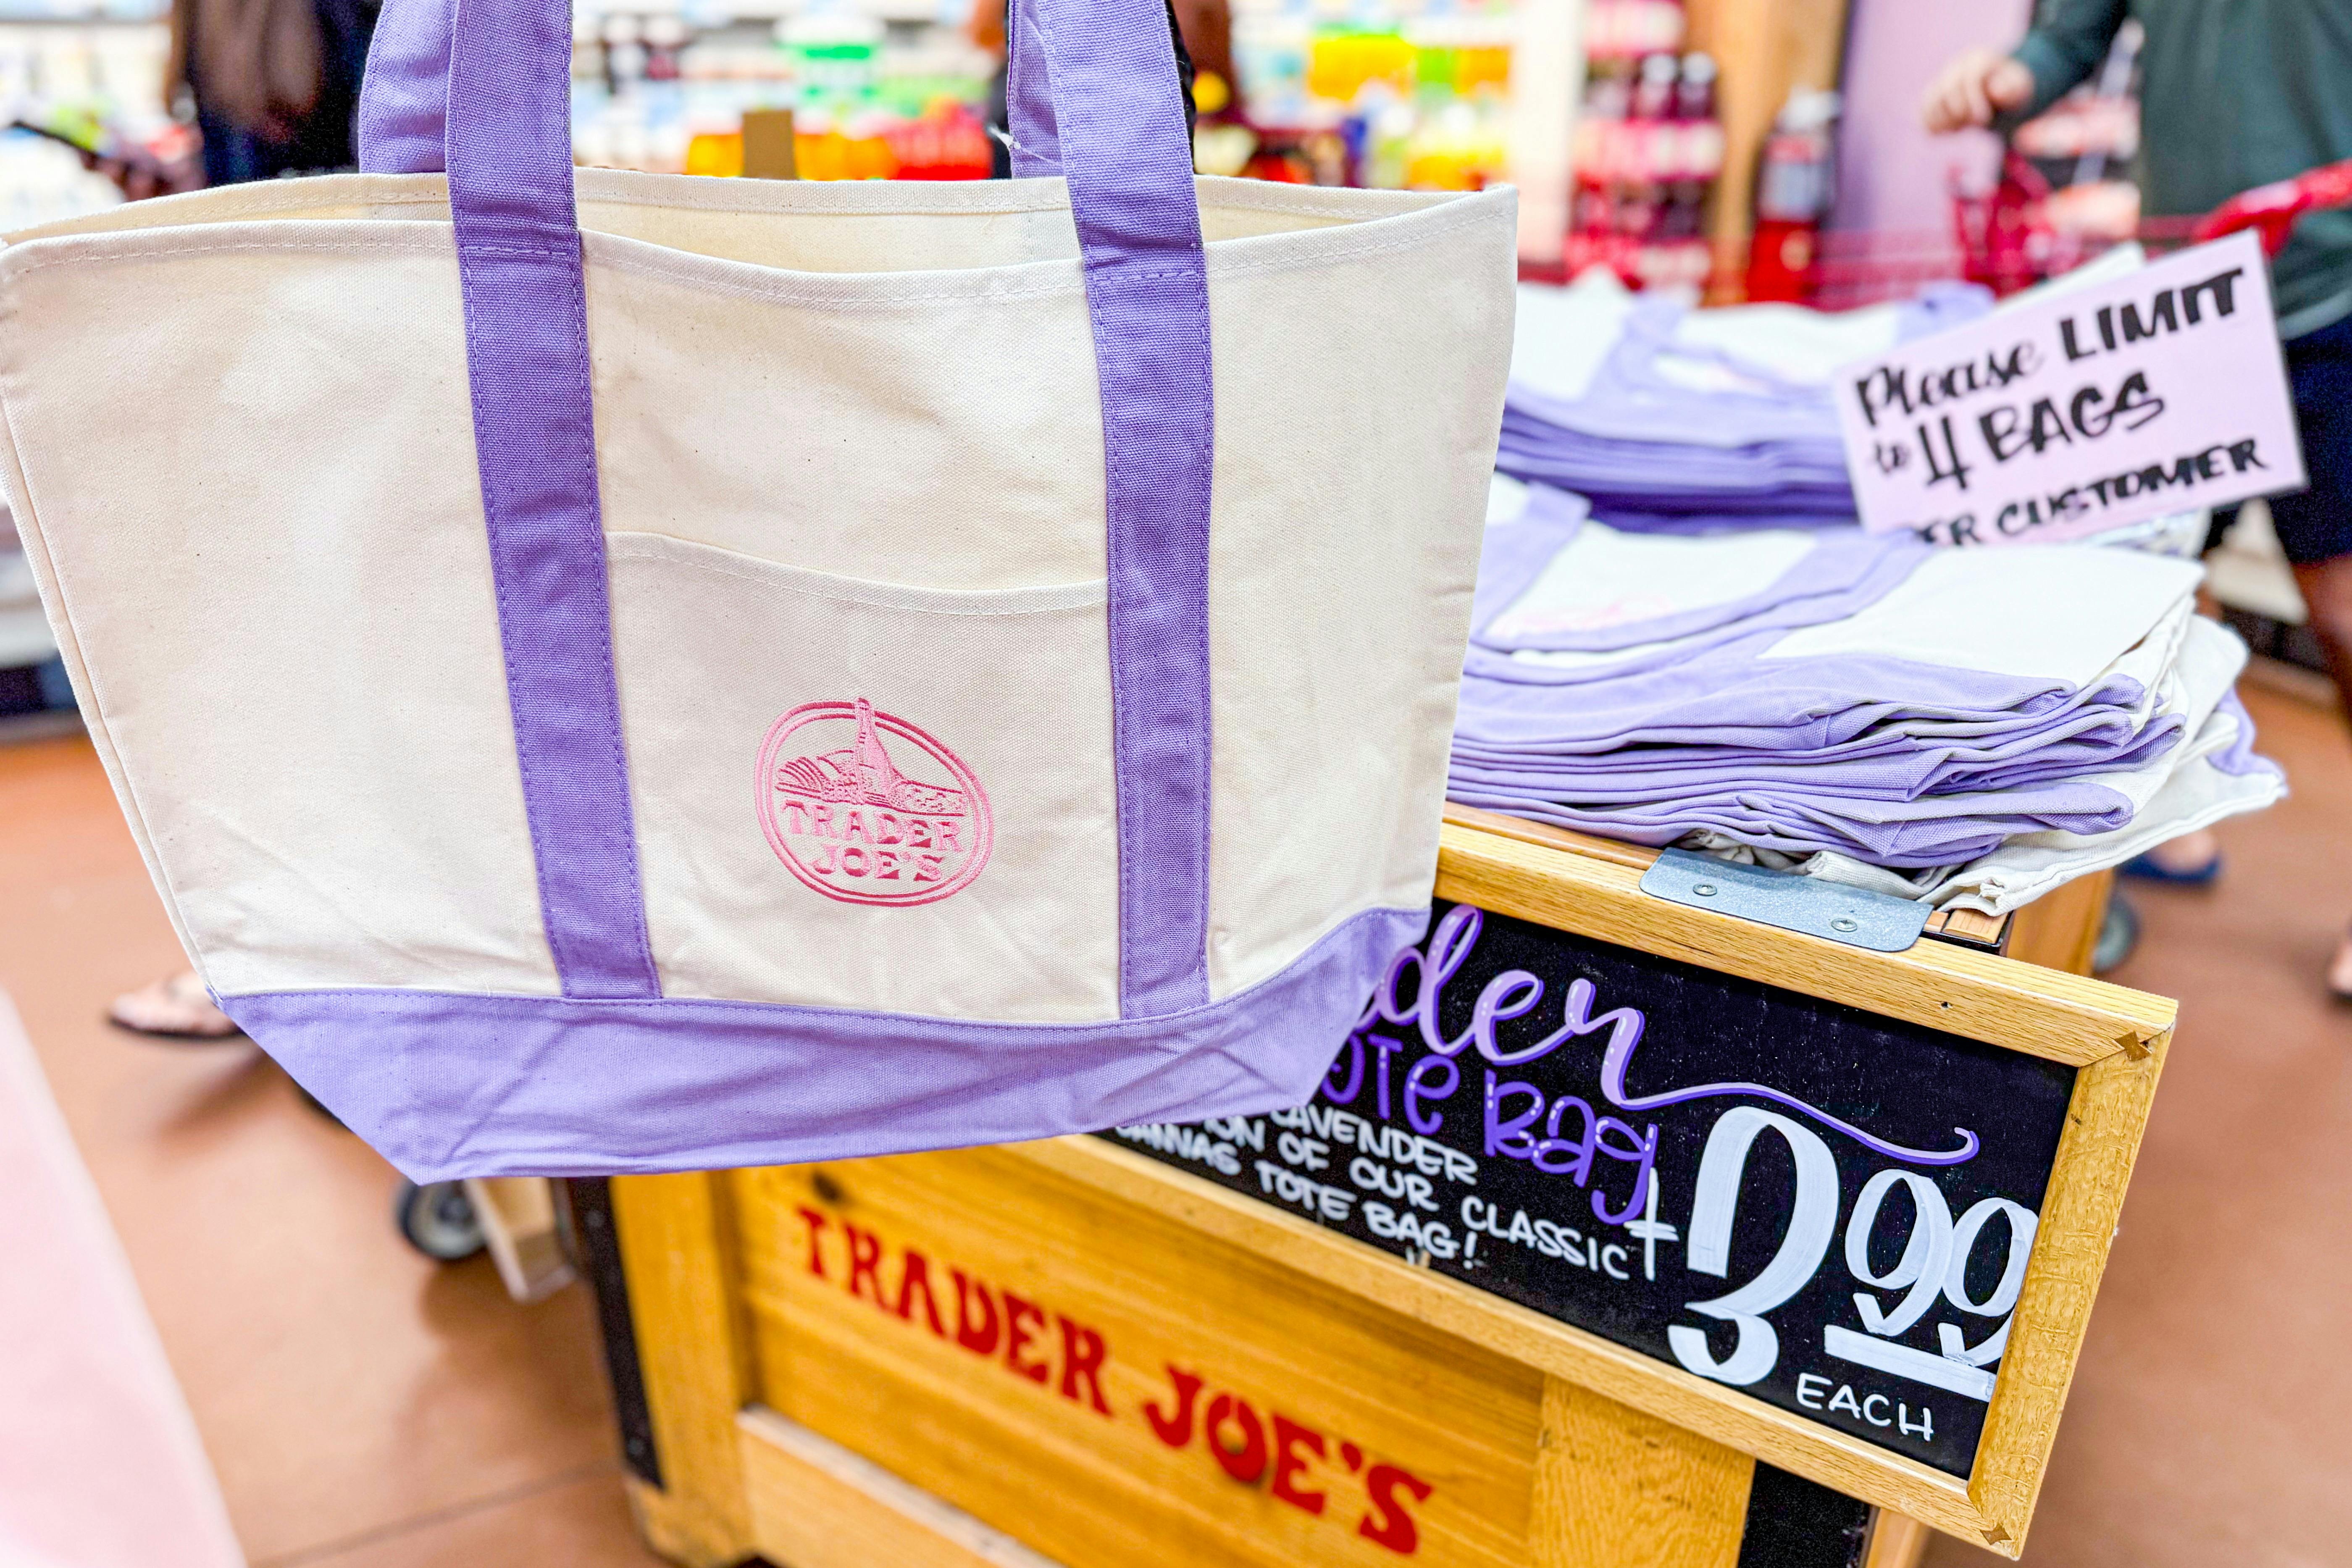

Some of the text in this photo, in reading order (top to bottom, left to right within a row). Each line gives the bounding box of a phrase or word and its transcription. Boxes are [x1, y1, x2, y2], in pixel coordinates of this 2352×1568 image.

[1856, 268, 2244, 428] Please LIMIT
[1978, 371, 2165, 462] BAGS
[1996, 438, 2269, 537] CUSTOMER
[781, 799, 964, 852] TRADER
[811, 844, 944, 881] JOE'S
[1253, 1159, 1358, 1221] TOTE
[1361, 1200, 1473, 1271] BAG!
[1277, 1132, 1330, 1172] OF
[1349, 1156, 1440, 1212] OUR
[1460, 1196, 1630, 1280] CLASSIC
[798, 1208, 1432, 1555] TRADER JOE'S
[1796, 1373, 1933, 1441] EACH
